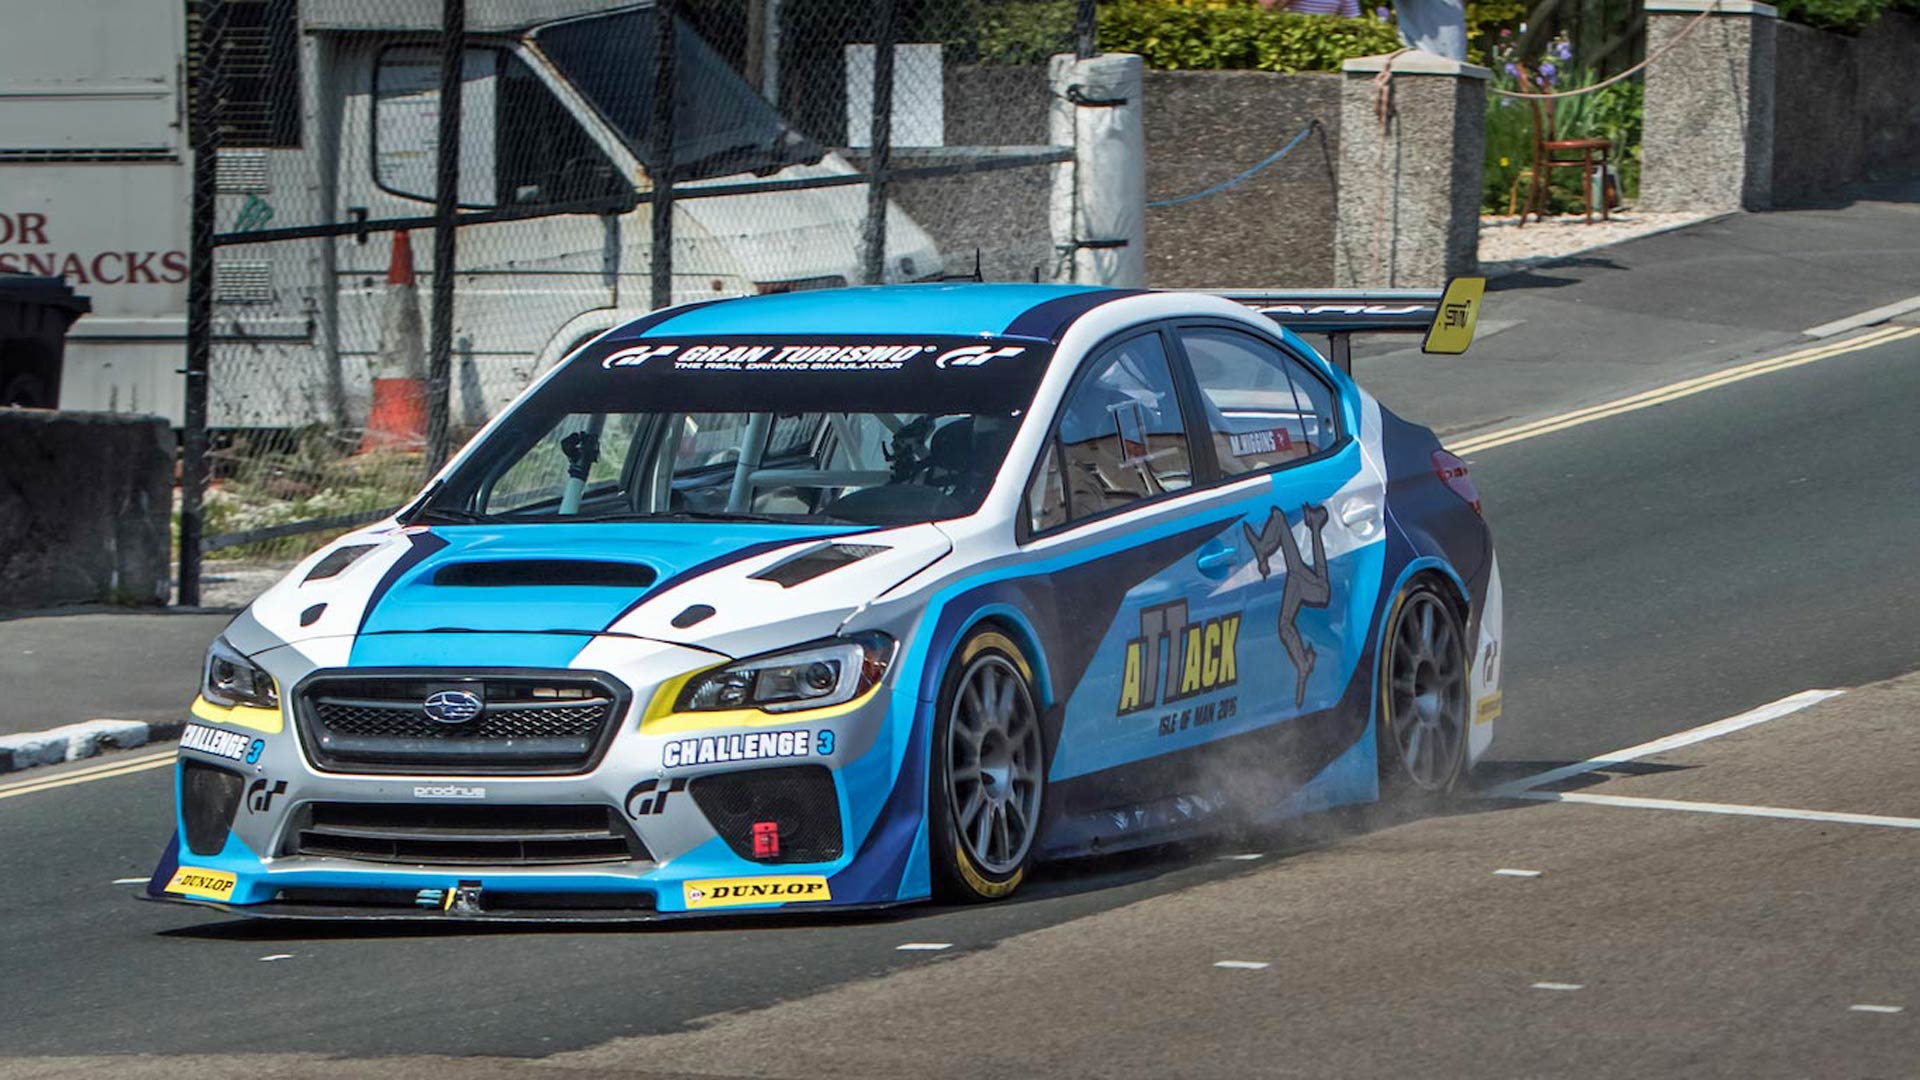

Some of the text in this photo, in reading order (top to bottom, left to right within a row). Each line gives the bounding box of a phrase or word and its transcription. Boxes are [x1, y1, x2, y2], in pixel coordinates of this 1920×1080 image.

[674, 362, 904, 370] THE REAL DRIVING SIMULATOR
[676, 345, 774, 362] GRAN
[1117, 597, 1242, 717] ATTACK
[1158, 712, 1178, 737] ISLE
[1180, 708, 1193, 731] OF
[1193, 702, 1216, 727] MAN
[180, 722, 265, 765] CHALLENGE 3
[662, 729, 836, 769] CHALLENGE 3
[180, 874, 234, 892] DUNLOP
[710, 883, 823, 899] DUNLOP
